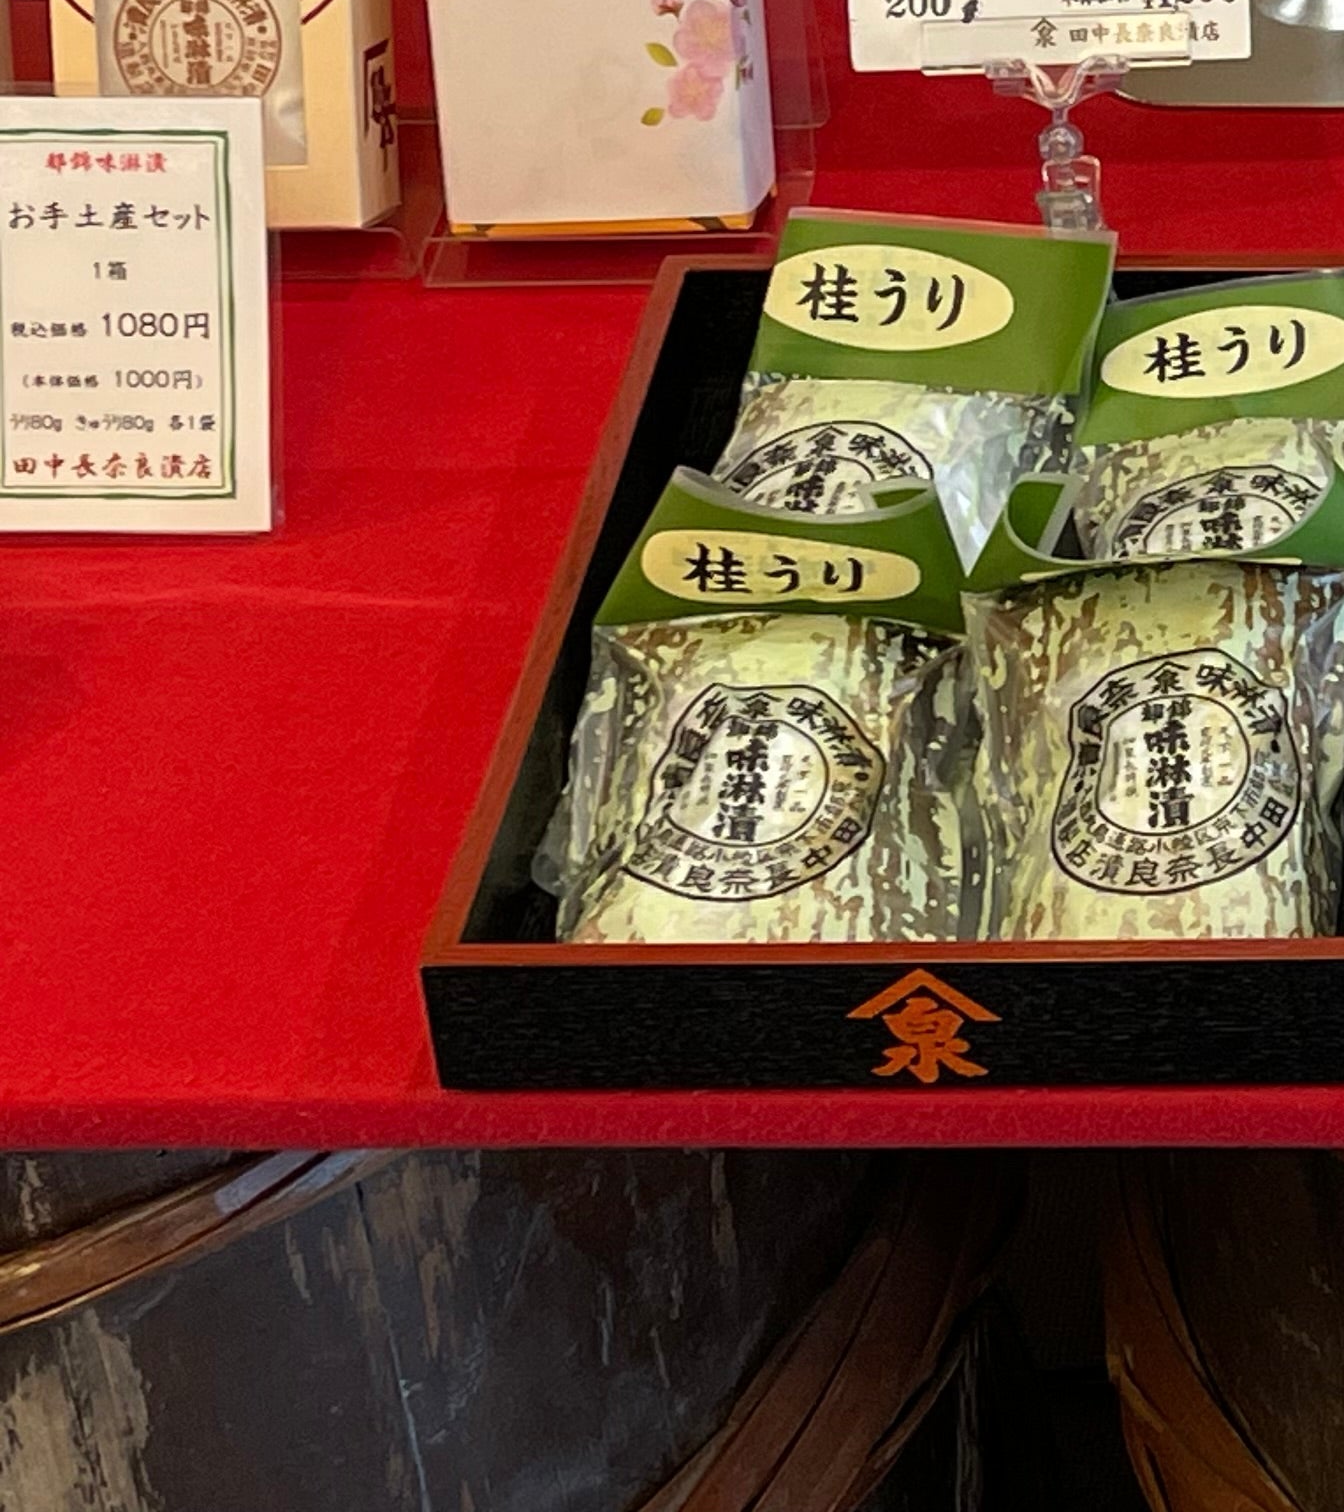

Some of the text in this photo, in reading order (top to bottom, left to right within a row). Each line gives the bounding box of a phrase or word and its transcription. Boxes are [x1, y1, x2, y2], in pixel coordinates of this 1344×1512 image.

[8, 201, 211, 230] お手土産セット
[93, 261, 128, 282] 1箱
[798, 262, 967, 331] 桂うり
[101, 312, 211, 341] 1080円
[1144, 318, 1308, 385] 桂うり
[12, 452, 213, 479] 田中長奈良漬店
[685, 543, 864, 596] 桂うり
